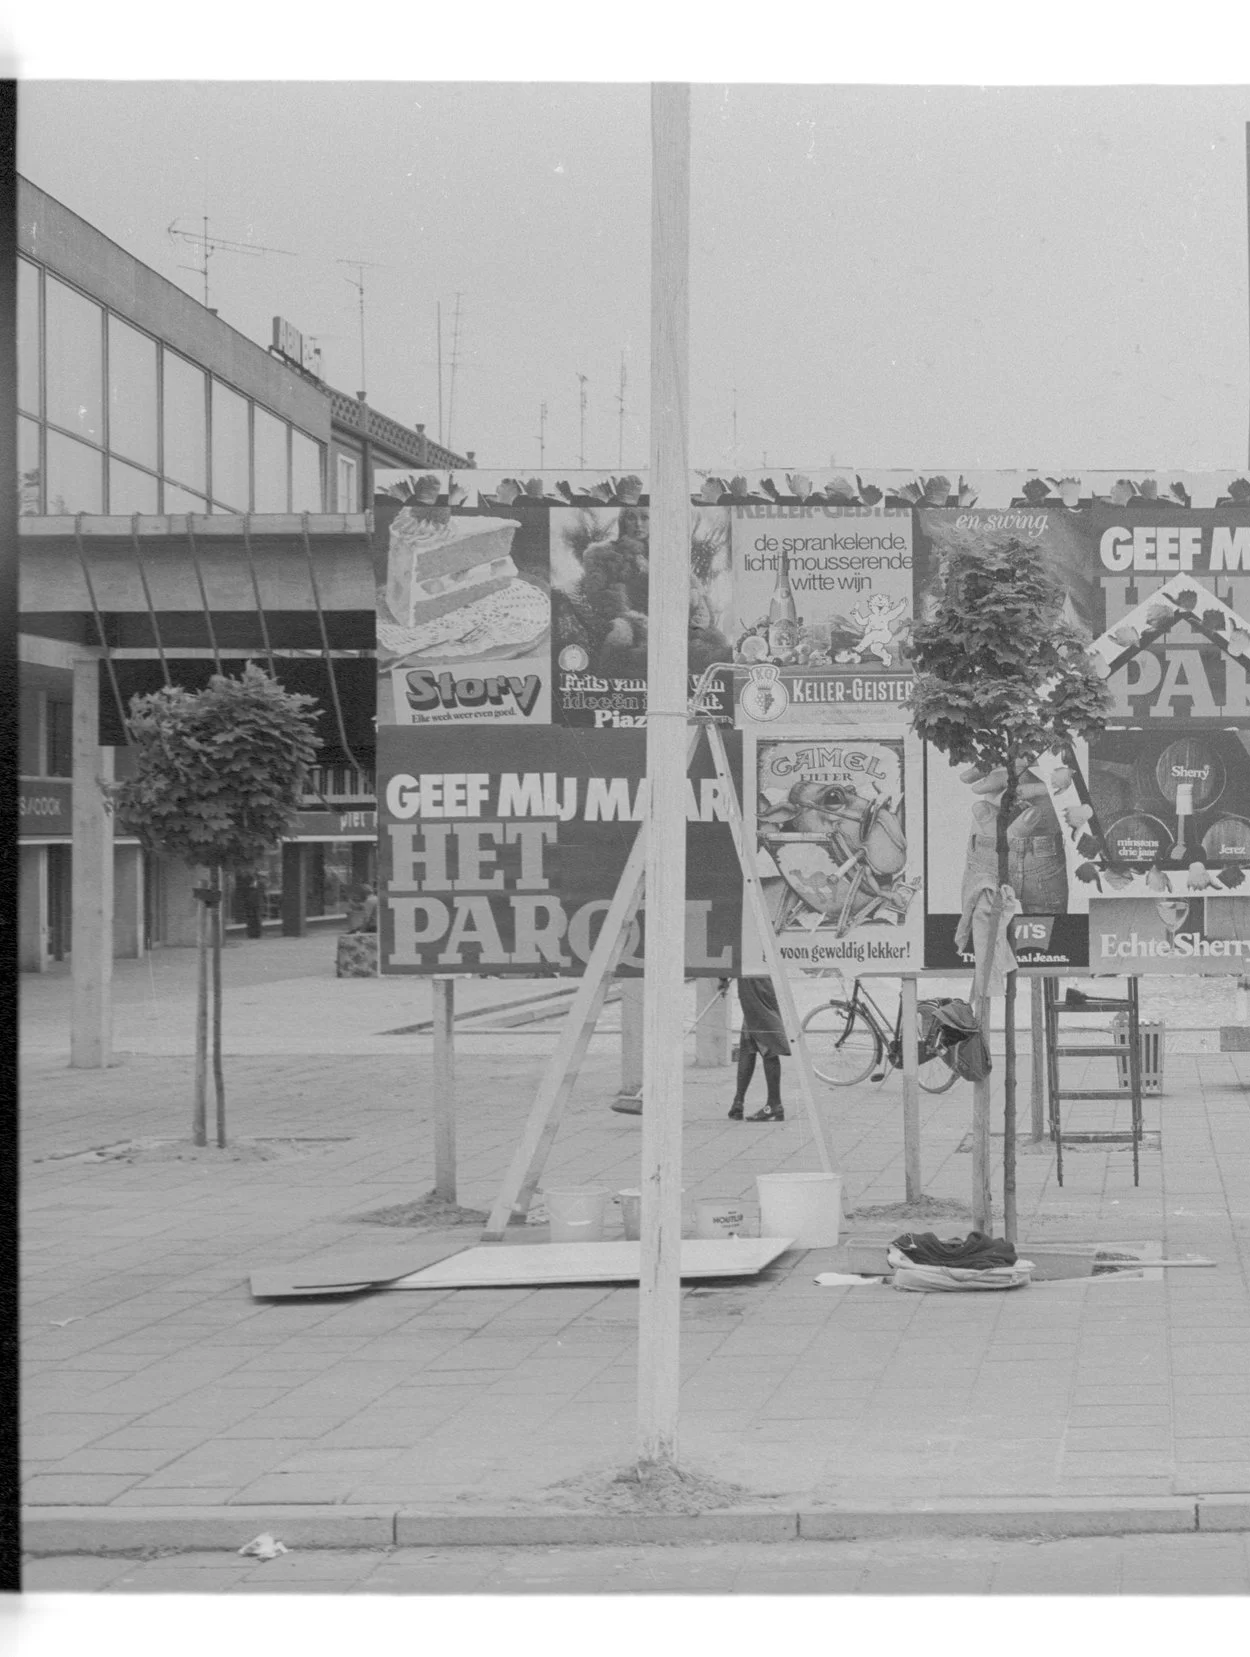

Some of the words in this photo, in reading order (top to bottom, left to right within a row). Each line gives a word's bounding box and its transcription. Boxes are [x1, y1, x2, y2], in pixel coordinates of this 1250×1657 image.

[955, 514, 980, 529] en
[983, 511, 1049, 537] swing.
[754, 534, 779, 551] de
[1100, 526, 1202, 571] GEEF
[787, 552, 913, 571] mousserende
[791, 574, 834, 591] witte
[838, 572, 872, 593] wijn
[559, 673, 609, 692] Frits
[609, 678, 647, 692] van
[406, 670, 541, 717] Story
[562, 692, 639, 710] ideeën
[432, 712, 452, 722] week
[474, 710, 493, 718] even
[770, 747, 887, 780] CAMEL
[800, 773, 853, 782] FILTER
[386, 773, 489, 819] GEEF
[388, 822, 558, 891] HET
[811, 941, 865, 963] geweldig
[867, 941, 911, 960] lekker!
[1101, 933, 1170, 958] Echte
[1033, 952, 1069, 963] Jeans.
